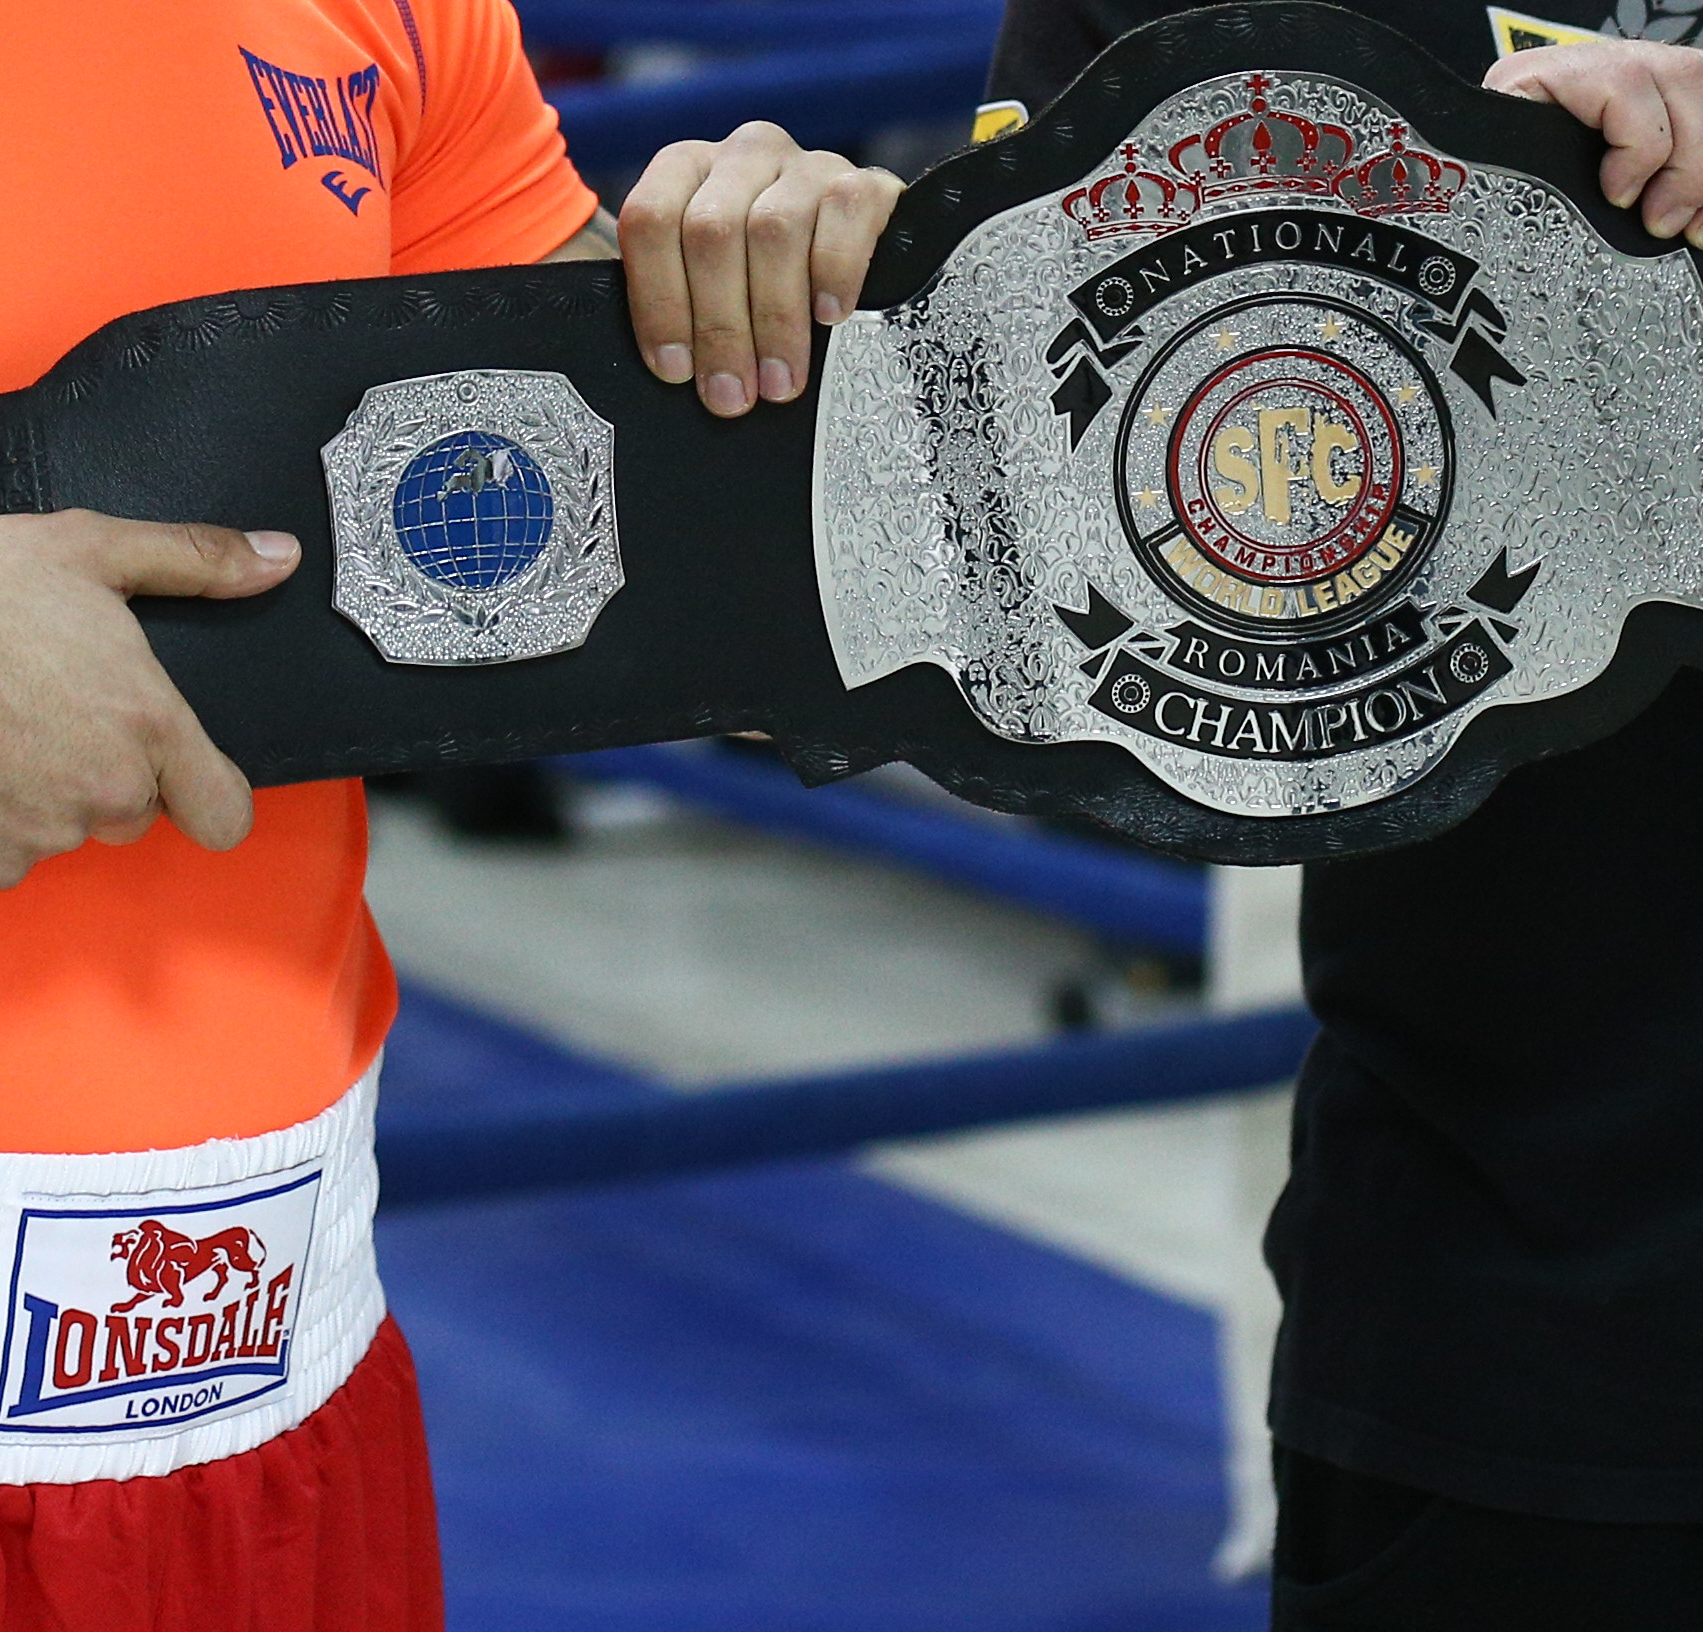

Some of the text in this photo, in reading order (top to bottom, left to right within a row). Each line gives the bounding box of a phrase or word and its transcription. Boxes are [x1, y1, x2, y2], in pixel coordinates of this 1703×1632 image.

[1139, 220, 1408, 294] NATIONAL
[1213, 407, 1362, 526] SFC
[1165, 522, 1415, 618] WORLD LEAGUE
[1186, 483, 1388, 574] CHAMPIONSHIP
[1183, 621, 1411, 683] ROMANIA
[1154, 666, 1448, 754] CHAMPION
[7, 1262, 295, 1419] LONSDALE
[125, 1381, 224, 1420] LONDON
